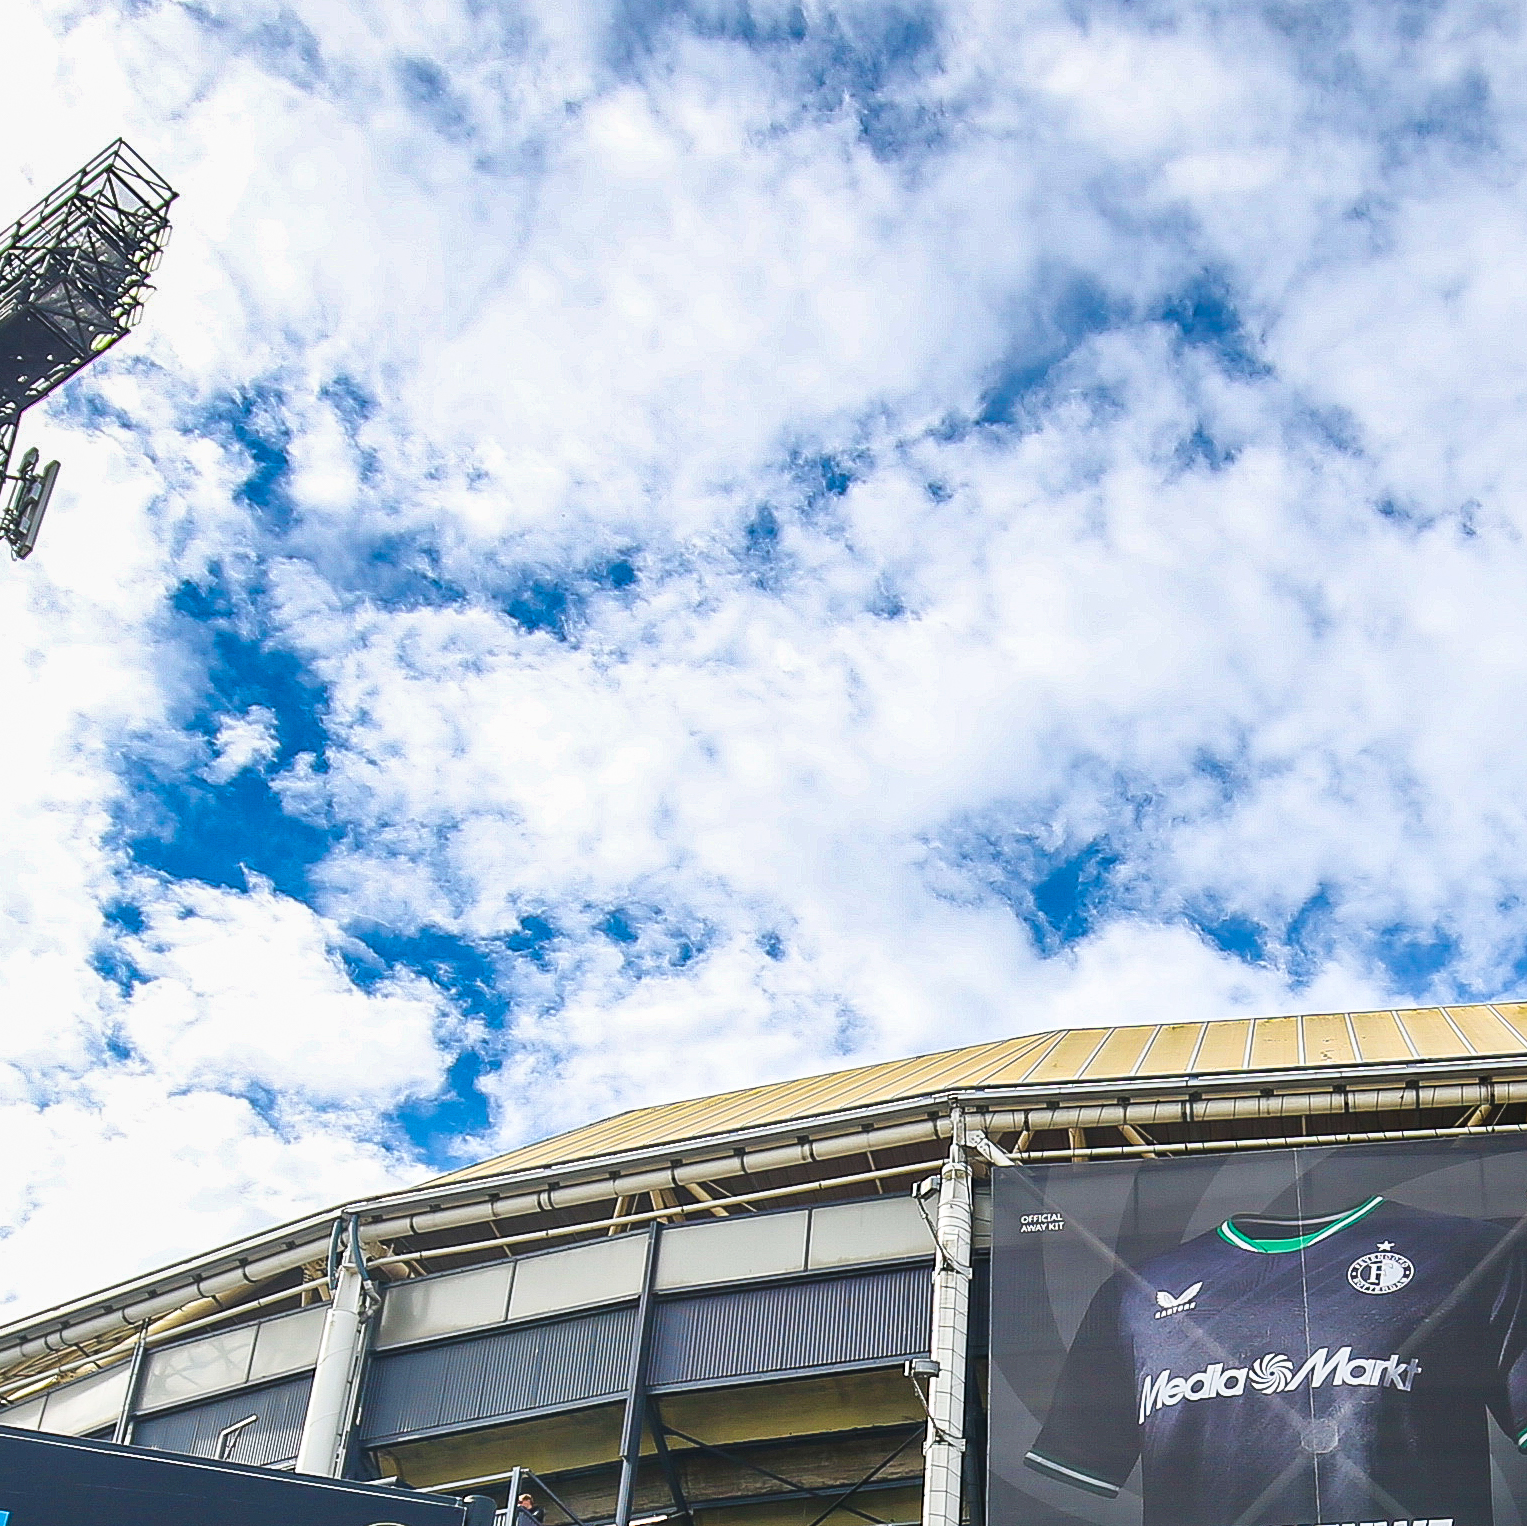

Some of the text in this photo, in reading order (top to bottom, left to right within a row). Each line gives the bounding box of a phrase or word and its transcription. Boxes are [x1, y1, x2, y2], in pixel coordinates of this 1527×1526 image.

[1020, 1213, 1063, 1223] OFFICIAL
[1020, 1222, 1065, 1233] AWAY KIT
[1138, 1347, 1422, 1425] Media Markt
